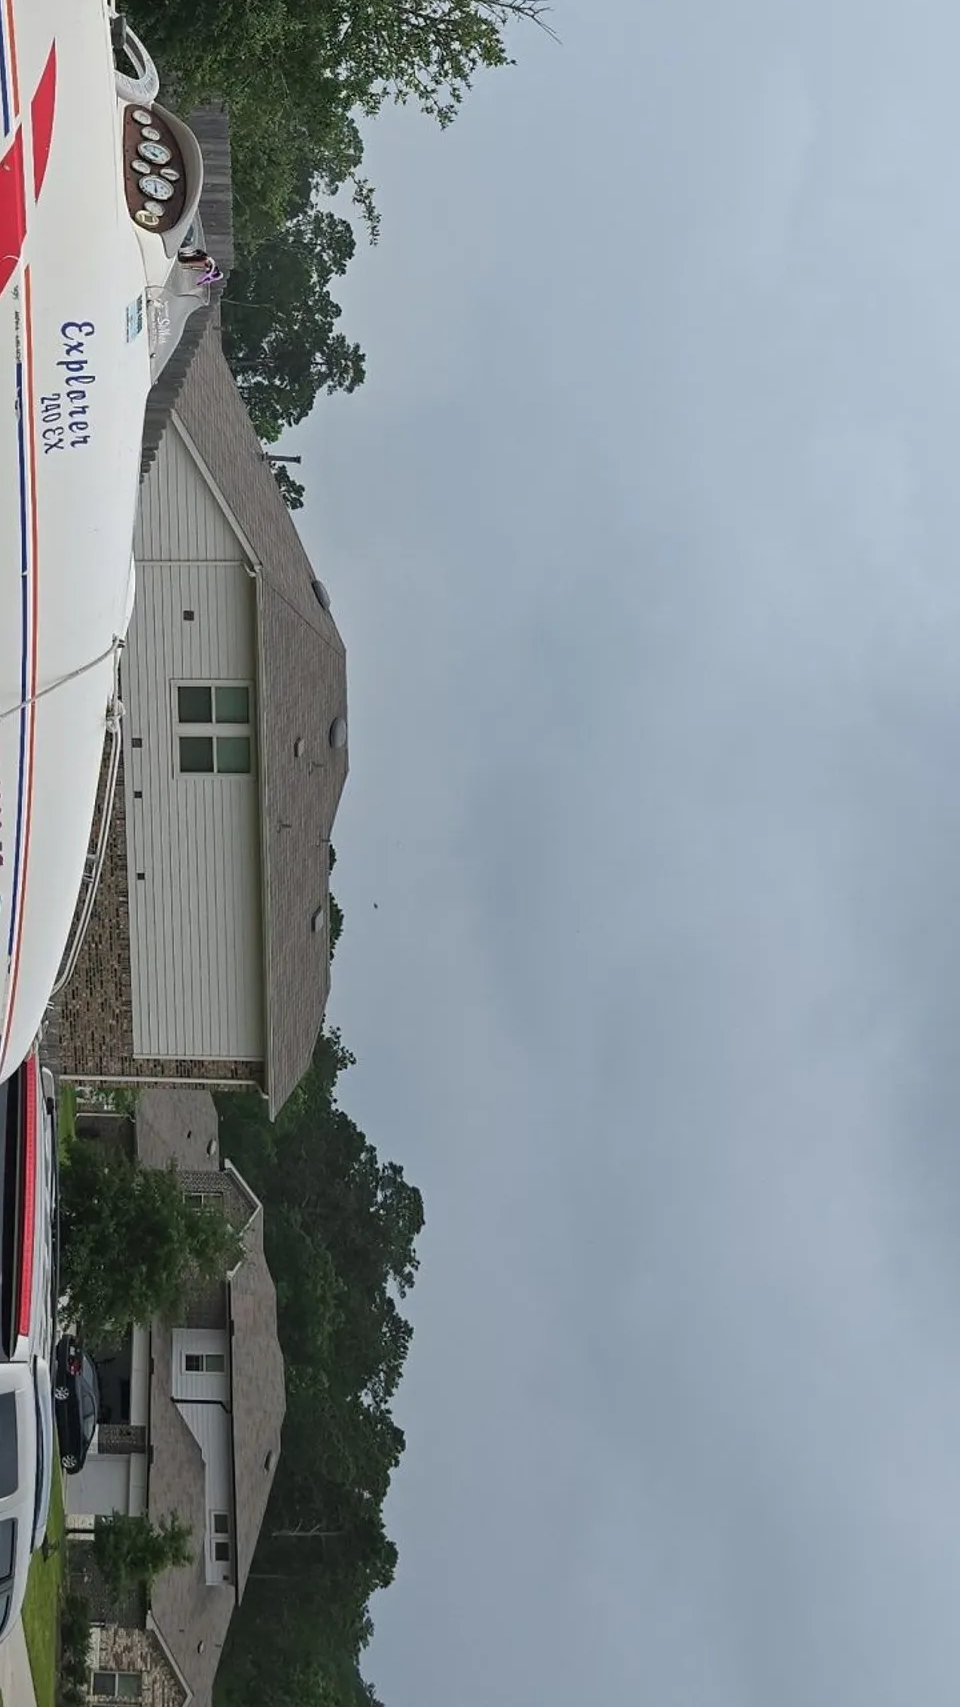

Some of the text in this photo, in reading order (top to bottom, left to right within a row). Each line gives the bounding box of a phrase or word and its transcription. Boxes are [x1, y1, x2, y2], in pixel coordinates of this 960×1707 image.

[40, 393, 65, 454] 240 EX
[56, 321, 96, 448] Explorer
